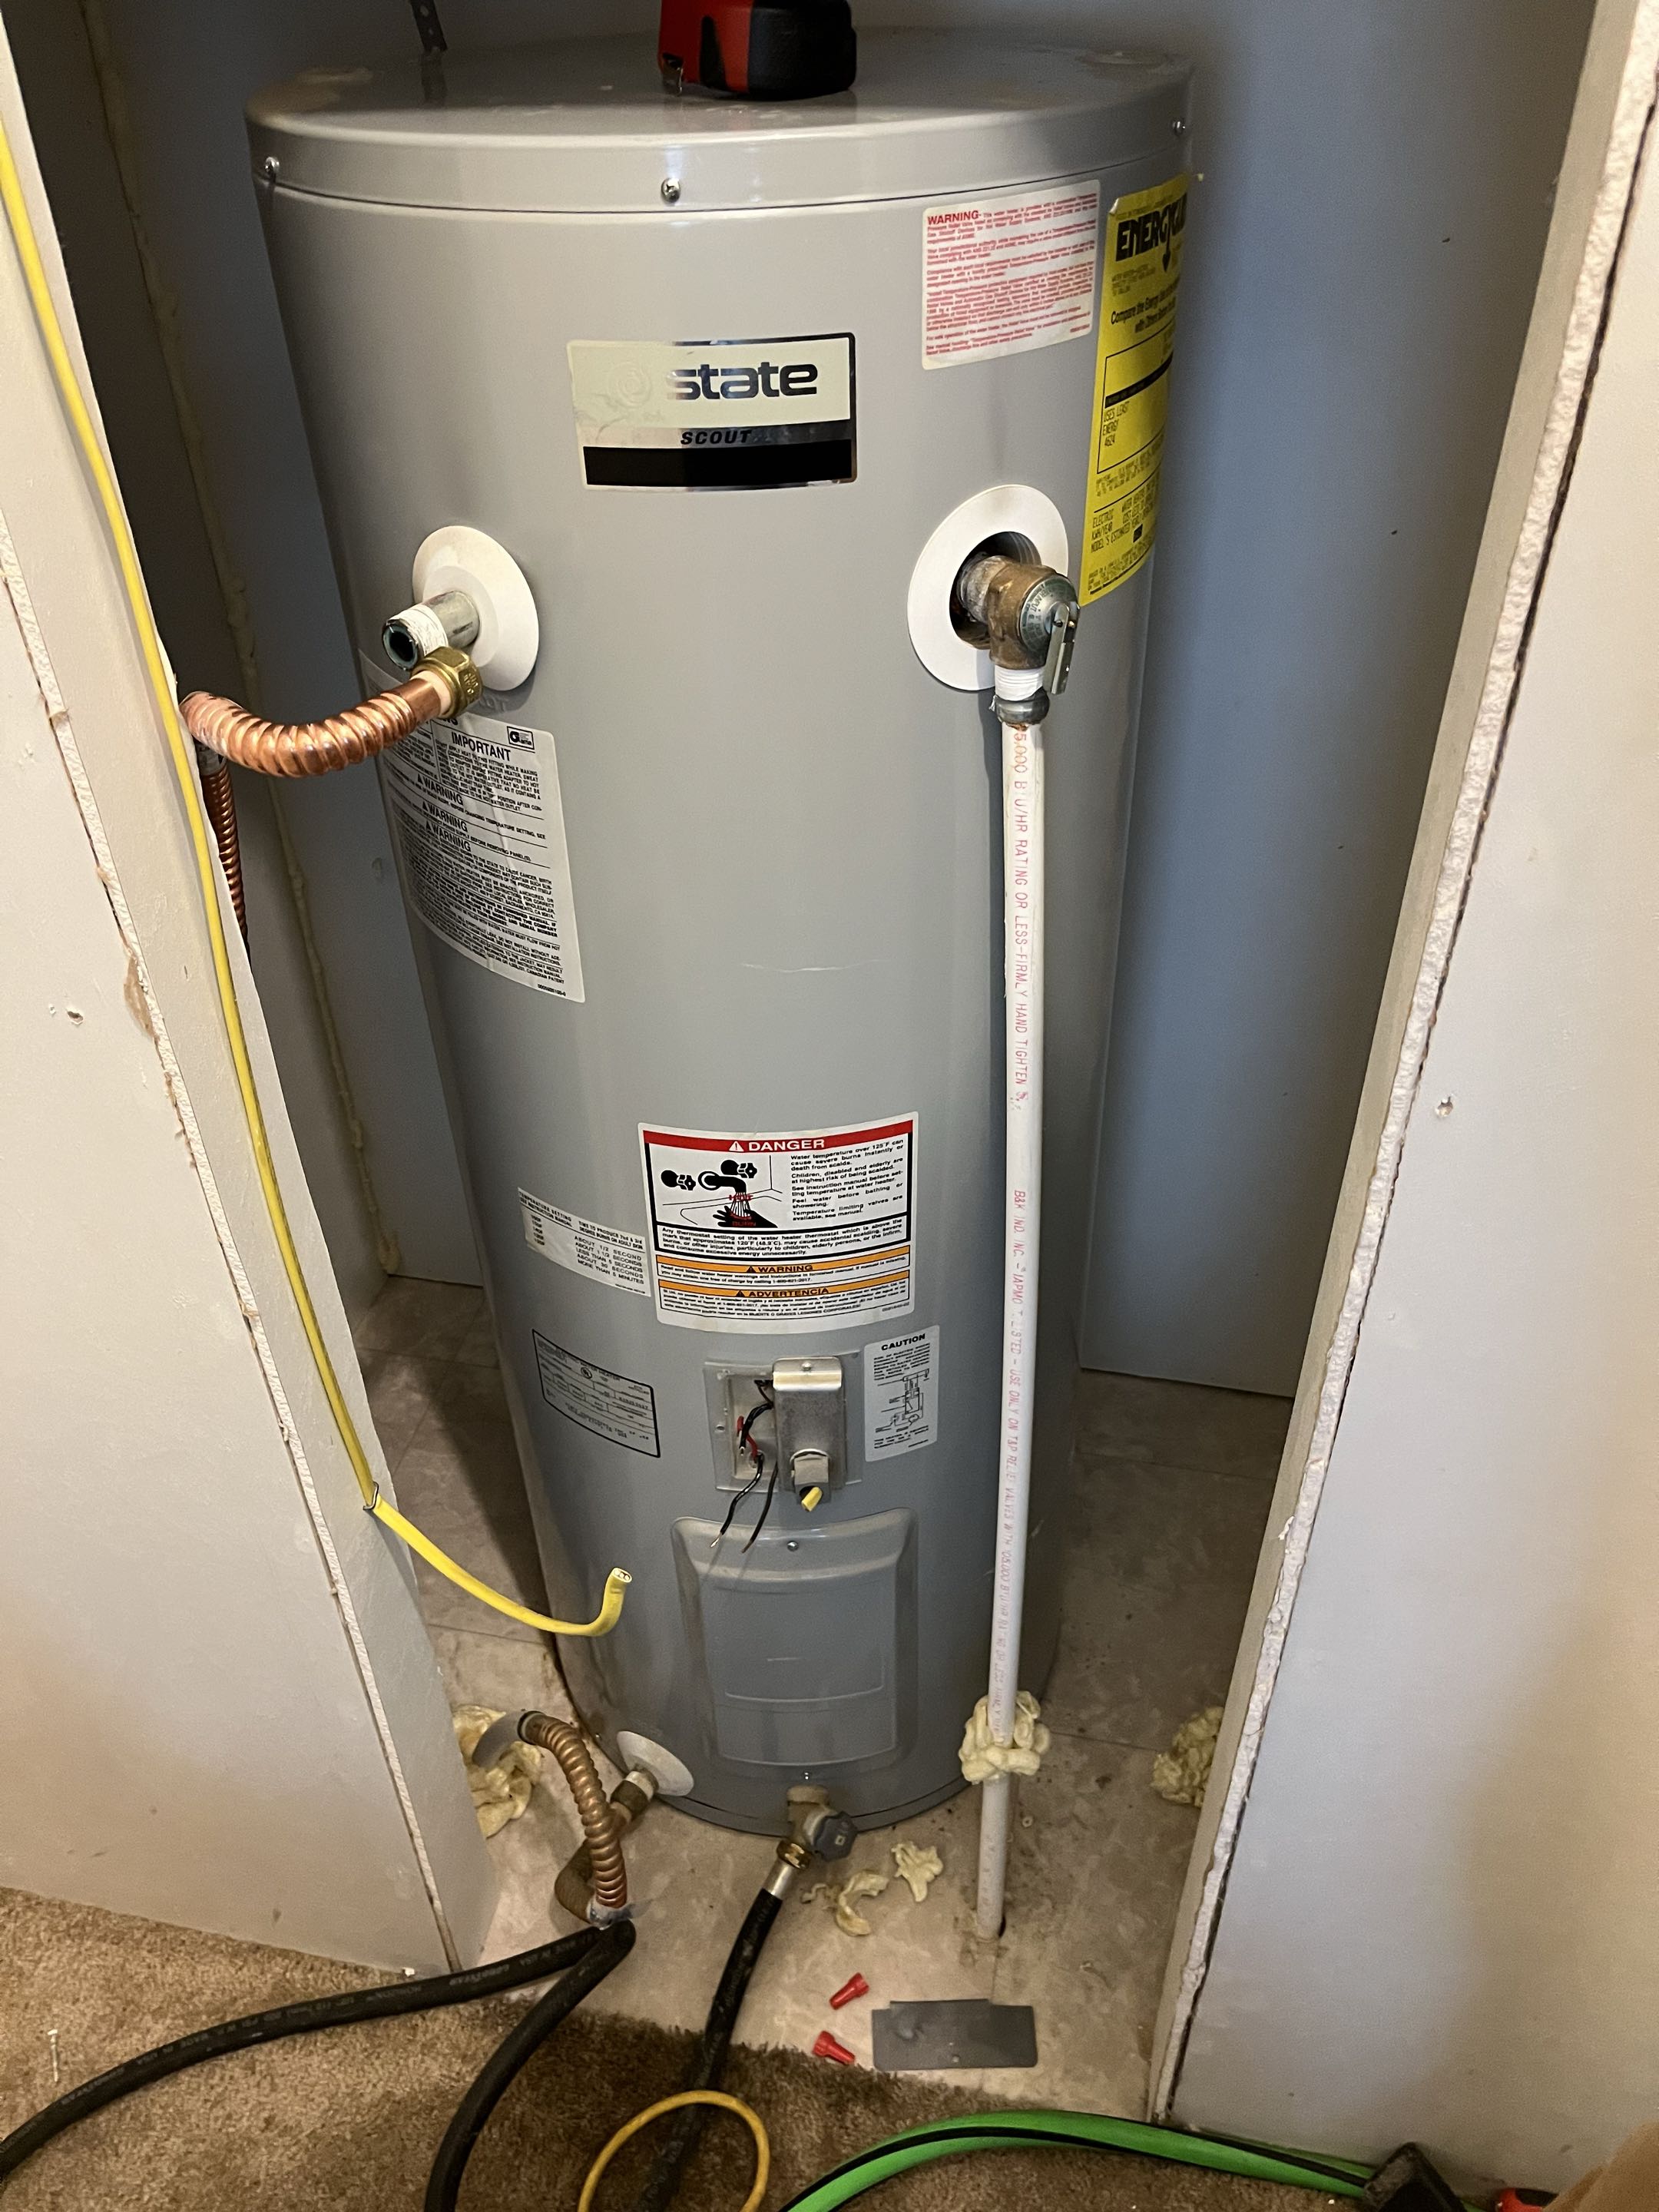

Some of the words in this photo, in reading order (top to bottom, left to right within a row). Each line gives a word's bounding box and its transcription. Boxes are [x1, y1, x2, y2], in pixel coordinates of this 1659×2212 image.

[667, 362, 818, 400] state
[680, 429, 752, 445] SCOUT
[452, 732, 511, 761] IMPORTANT
[423, 777, 463, 805] WARNING
[429, 804, 468, 832] WARNING
[1015, 780, 1028, 832] BU/HR
[432, 823, 471, 852] WARNING
[1015, 839, 1028, 885] RATING
[1015, 892, 1028, 909] OR
[1015, 1003, 1028, 1033] HAND
[1015, 1039, 1028, 1084] TIGHTEN
[749, 1138, 825, 1151] DANGER
[813, 1149, 853, 1159] temperature
[865, 1147, 892, 1156] instantly
[824, 1167, 852, 1176] disabled
[869, 1164, 894, 1174] scalded.
[807, 1187, 846, 1196] temperature
[866, 1186, 889, 1194] bathing
[1015, 1190, 1025, 1210] B&K
[677, 1230, 710, 1238] thermostat
[575, 1236, 594, 1247] ABOUT
[613, 1250, 641, 1261] SECOND
[575, 1242, 594, 1253] ABOUT
[613, 1255, 642, 1267] SECONDS
[576, 1248, 590, 1257] LESS
[591, 1253, 607, 1263] THAN
[615, 1261, 643, 1273] SECONDS
[577, 1253, 597, 1264] ABOUT
[612, 1267, 644, 1279] SECONDS
[578, 1259, 594, 1269] MORE
[595, 1266, 610, 1275] THAN
[618, 1273, 644, 1284] MINUTES
[749, 1288, 830, 1298] ADVERTENCIA
[881, 1333, 926, 1351] CAUTION
[1010, 1321, 1022, 1354] STED
[1009, 1369, 1020, 1386] USE
[1008, 1390, 1020, 1414] ONLY
[1008, 1418, 1018, 1431] ON
